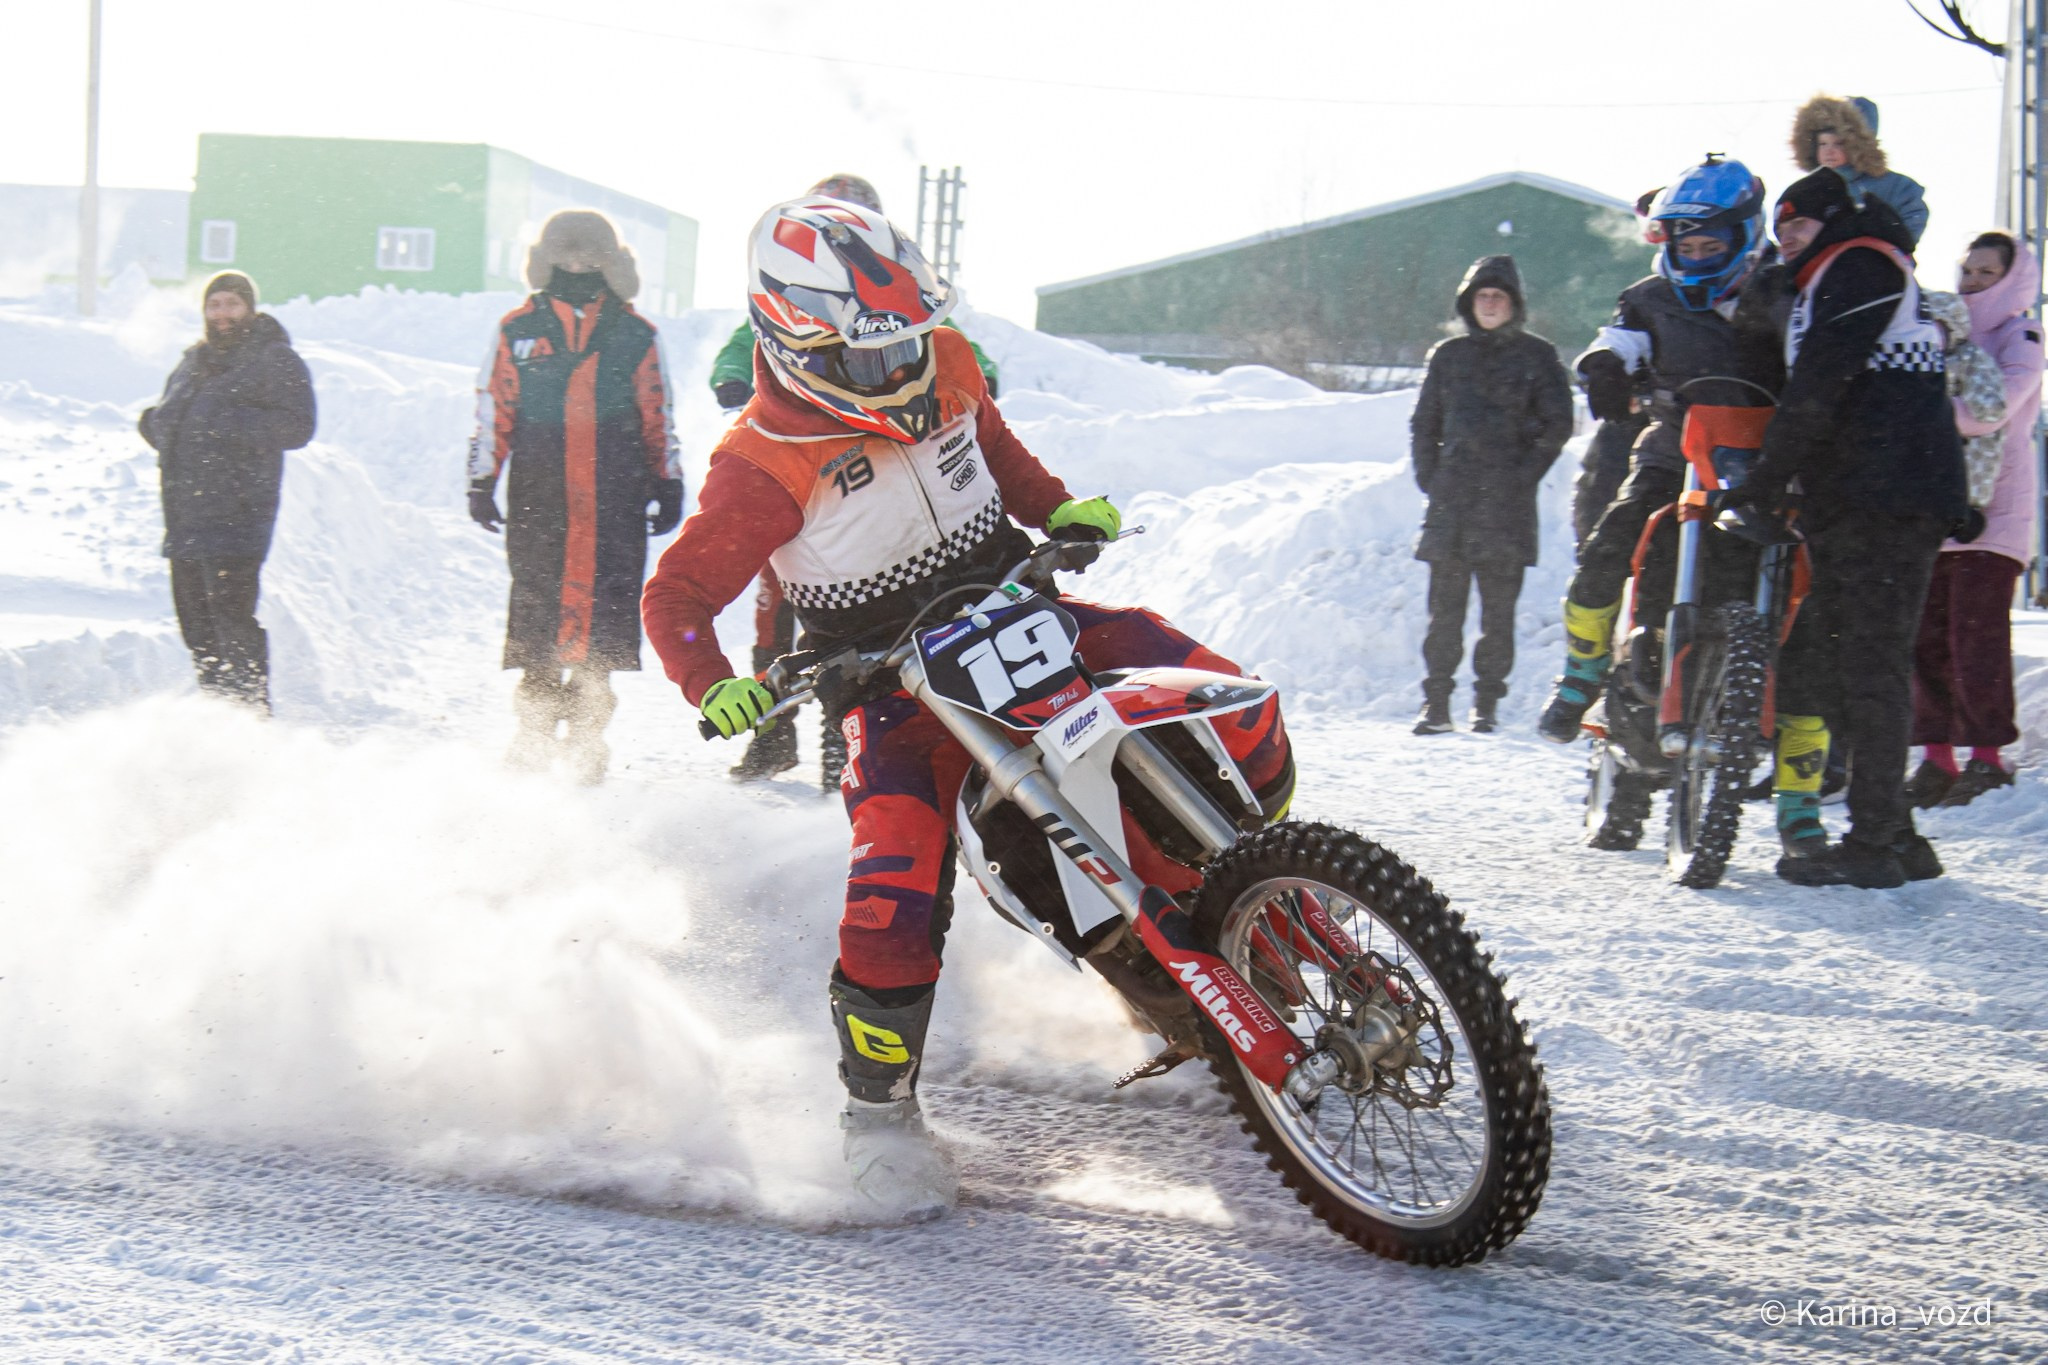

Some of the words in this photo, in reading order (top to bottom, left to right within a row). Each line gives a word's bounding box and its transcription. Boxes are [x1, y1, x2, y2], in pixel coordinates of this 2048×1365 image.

[855, 314, 903, 334] Airoh
[754, 325, 809, 370] AKLEY
[831, 454, 875, 499] 19
[957, 609, 1074, 715] 19
[1062, 706, 1098, 746] Mitas
[1169, 961, 1257, 1053] Mitas
[1212, 966, 1278, 1033] BRAKING
